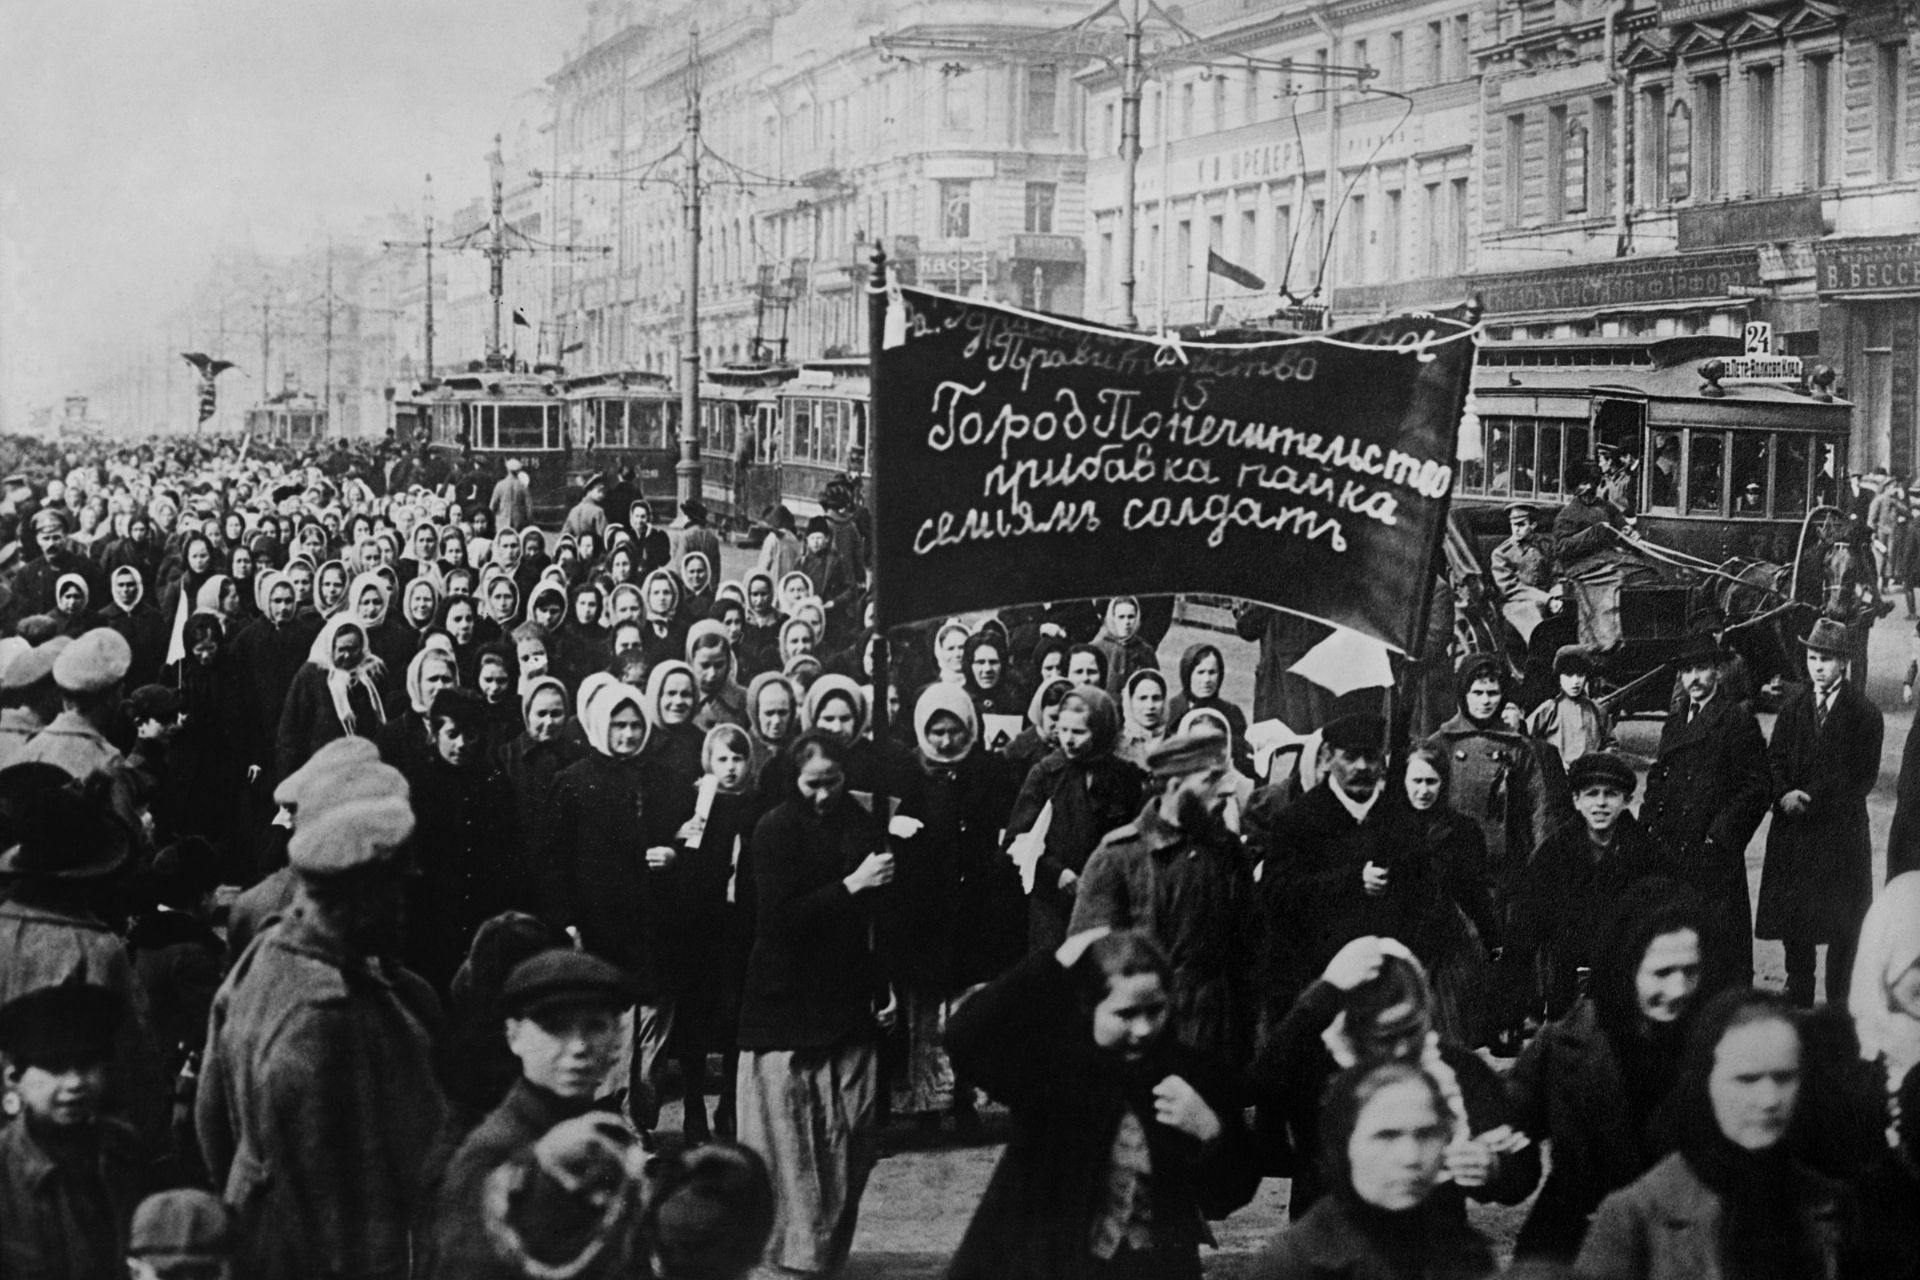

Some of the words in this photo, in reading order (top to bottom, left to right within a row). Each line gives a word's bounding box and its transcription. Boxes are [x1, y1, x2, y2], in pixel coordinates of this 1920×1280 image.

[1827, 264, 1844, 288] В.
[1746, 325, 1769, 354] 24
[927, 380, 1088, 461] Город
[1122, 494, 1348, 553] солдатъ
